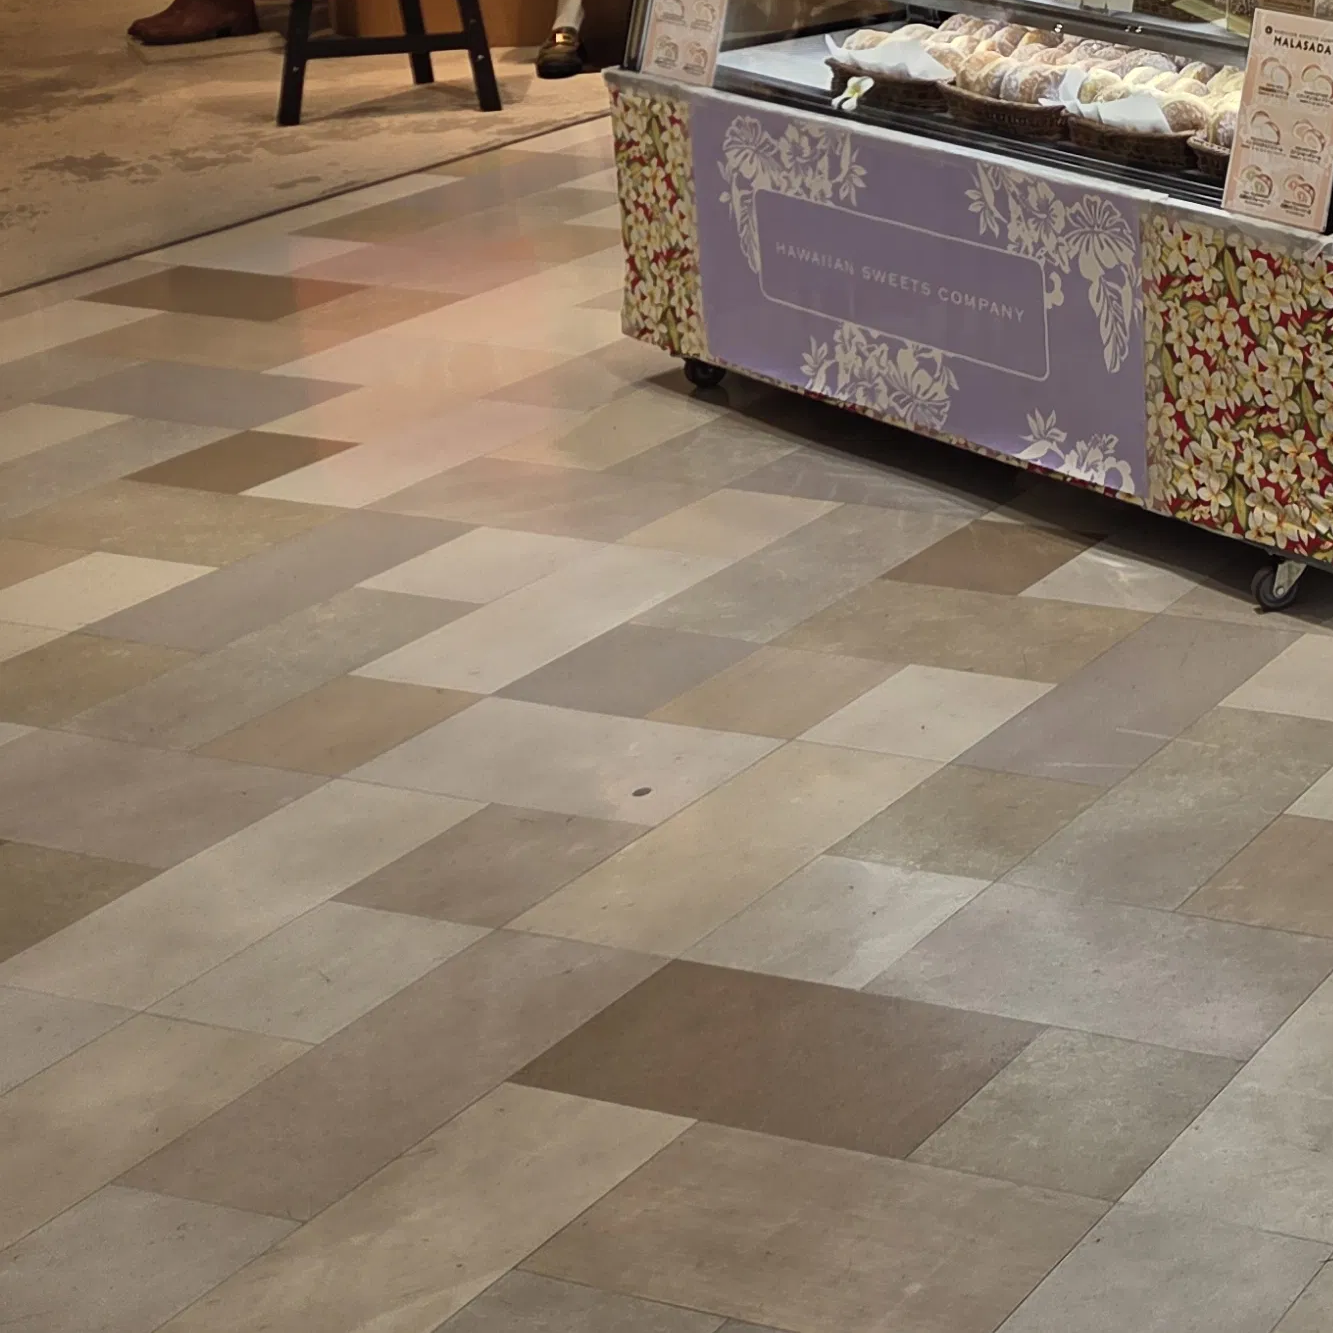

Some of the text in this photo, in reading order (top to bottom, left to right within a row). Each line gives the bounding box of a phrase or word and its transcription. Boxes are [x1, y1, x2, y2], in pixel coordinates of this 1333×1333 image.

[1273, 35, 1333, 56] MALASADA
[775, 241, 1024, 323] HAWAIIAN SWEETS COMPANY
